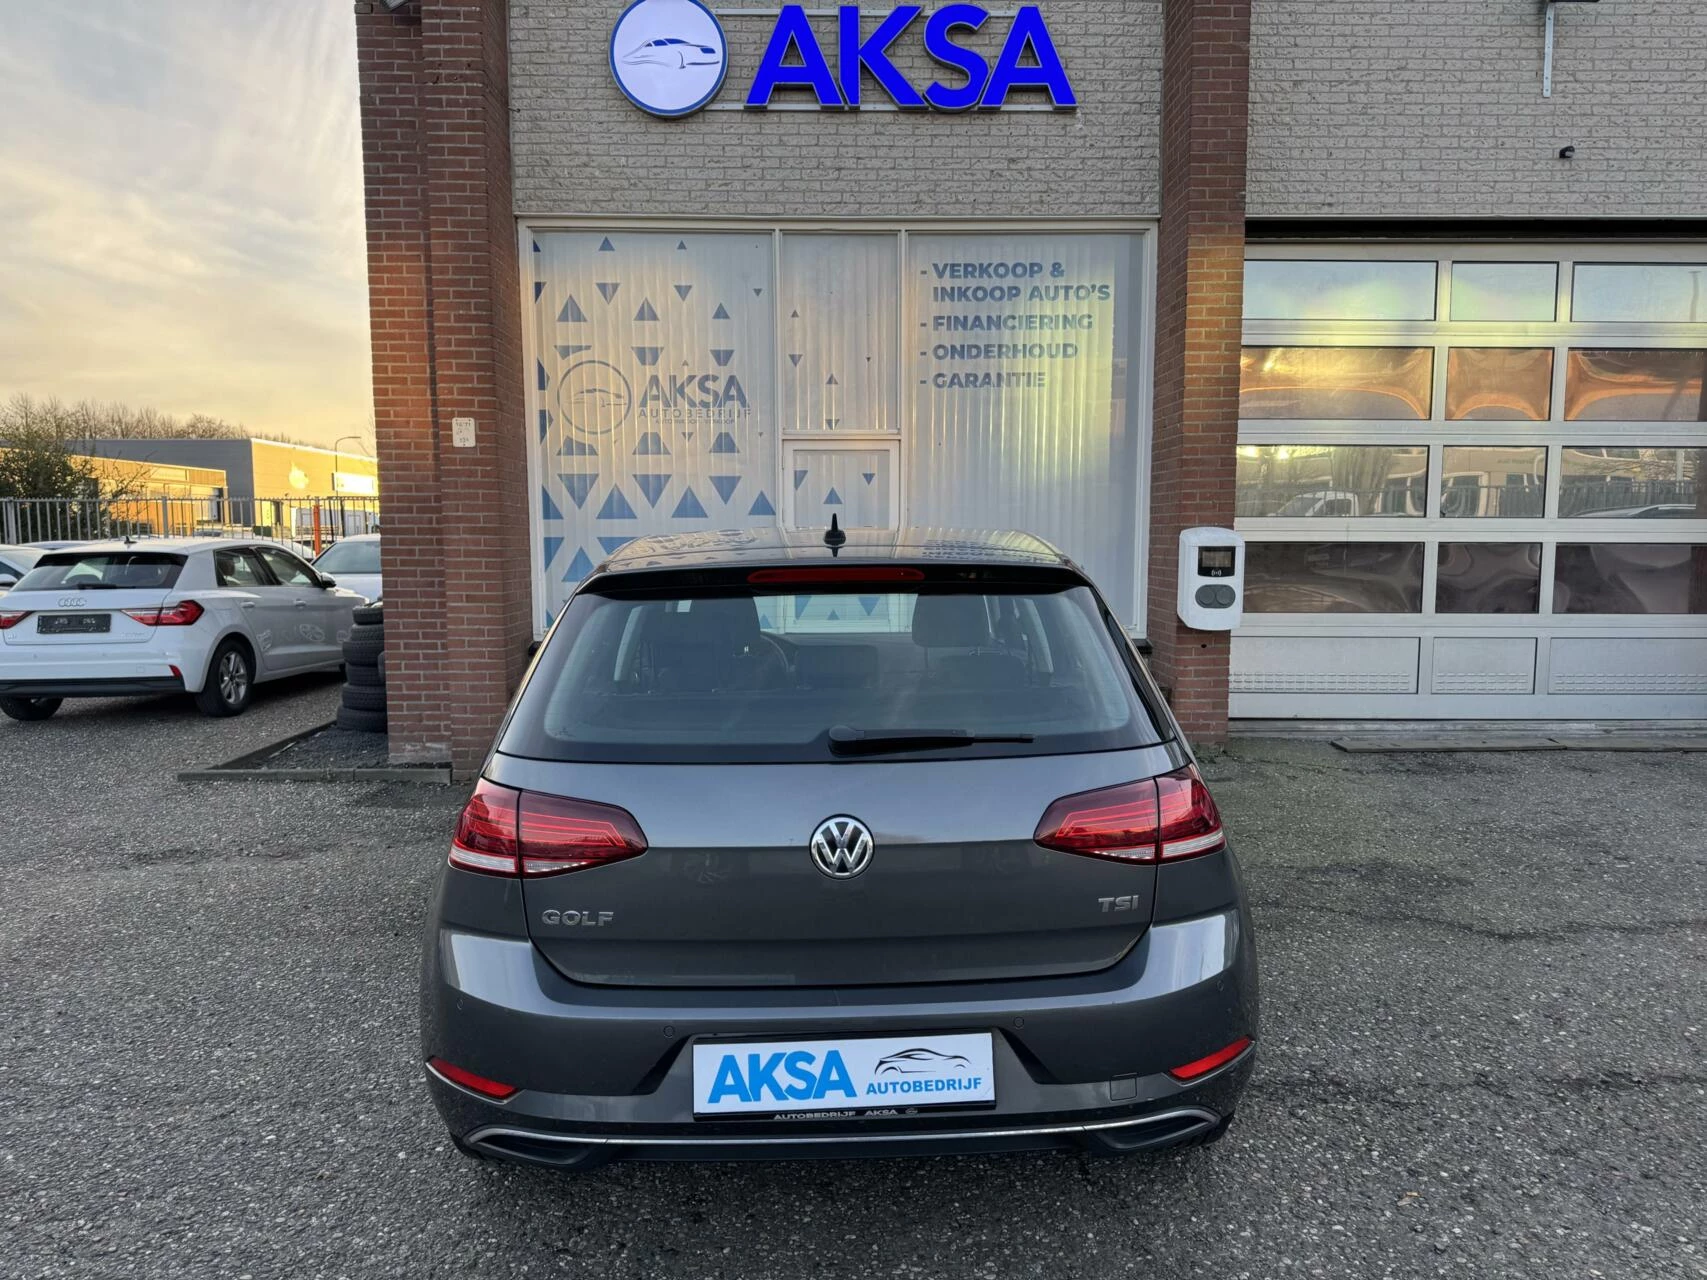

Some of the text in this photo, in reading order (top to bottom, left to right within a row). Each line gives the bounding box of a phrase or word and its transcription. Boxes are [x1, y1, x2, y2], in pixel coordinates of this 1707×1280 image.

[745, 3, 1077, 111] AKSA
[932, 262, 1043, 279] VERKOOP
[1049, 261, 1065, 278] &
[933, 284, 1110, 302] INKOOP AUTO'S
[932, 314, 1093, 331] FINANCIERING
[932, 343, 1078, 360] ONDERHOUD
[932, 372, 1046, 388] GARANTIE
[639, 375, 750, 408] AKSA
[638, 408, 752, 419] AUTOBEDRIJF
[1097, 895, 1139, 913] TSI
[542, 909, 615, 927] GOLF
[707, 1049, 982, 1104] AKSA AUTOBEDRIJF
[774, 1108, 898, 1121] AUTOBEDRIJF AKSA
